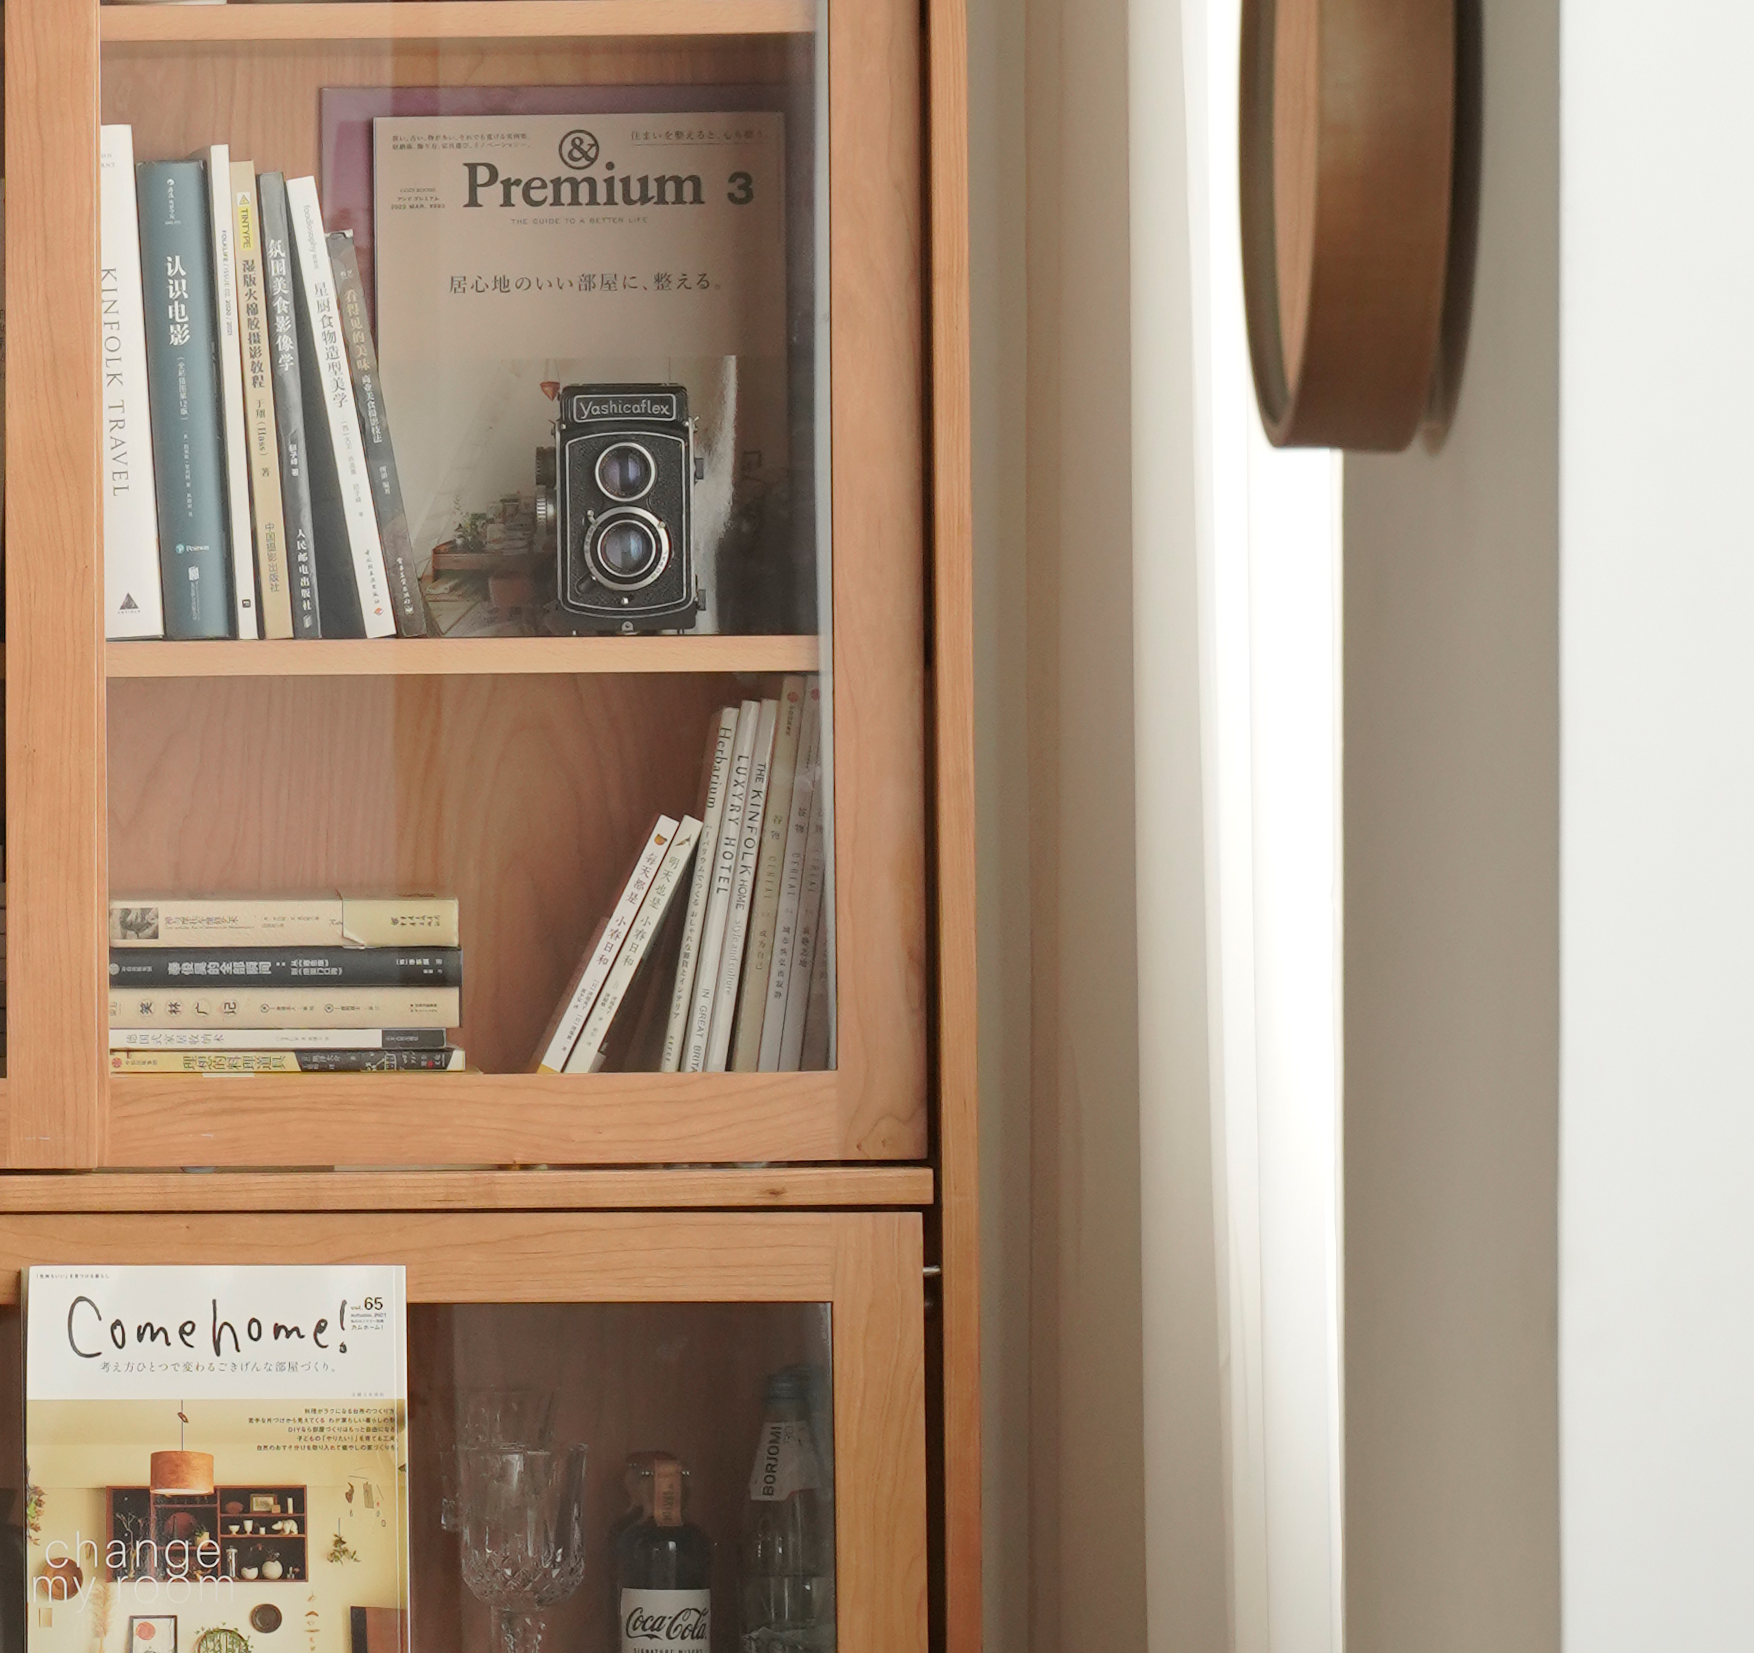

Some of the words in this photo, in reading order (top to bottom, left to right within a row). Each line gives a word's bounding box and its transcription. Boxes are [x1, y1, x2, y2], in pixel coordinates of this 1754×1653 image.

[462, 161, 706, 208] Premium
[726, 171, 755, 205] 3
[240, 207, 252, 249] TINTYPE
[510, 217, 528, 225] THE
[532, 217, 561, 225] GUIDE
[564, 217, 576, 225] TO
[589, 217, 625, 225] BETTER
[628, 217, 648, 225] LIFE
[166, 255, 191, 346] 认识电影
[268, 239, 294, 372] 氛围美食影像学
[449, 272, 723, 295] 居心地のいい部屋に、整える。
[101, 267, 124, 388] KINFOLK
[314, 282, 349, 408] 星厨食物造型美学
[345, 289, 371, 372] 看得见的美味
[579, 399, 671, 420] Yashicaflex
[107, 399, 130, 497] TRAVEL
[296, 529, 312, 611] 人民邮电出版社
[705, 726, 733, 809] Herbarium
[754, 762, 767, 784] THE
[738, 789, 763, 876] KINFOLK
[626, 852, 657, 906] 每天都是
[648, 855, 680, 910] 明天也是
[715, 836, 733, 896] HOTEL
[735, 877, 747, 911] HOME
[596, 915, 628, 967] 小春日和
[622, 915, 652, 968] 小春日和
[731, 920, 742, 942] style
[731, 942, 740, 961] and
[701, 988, 711, 999] IN
[726, 961, 736, 996] culture
[126, 1033, 225, 1045] 德国式家居收纳术
[696, 1005, 708, 1038] GREAT
[182, 1054, 286, 1071] 理想的料理道具
[99, 1360, 337, 1373] 考え方ひとつで変わるごきげんな部屋づくり。
[763, 1425, 783, 1497] BORJOMI
[45, 1530, 222, 1580] change
[33, 1575, 97, 1612] my
[113, 1574, 234, 1604] room
[626, 1606, 709, 1642] Coca-Cola
